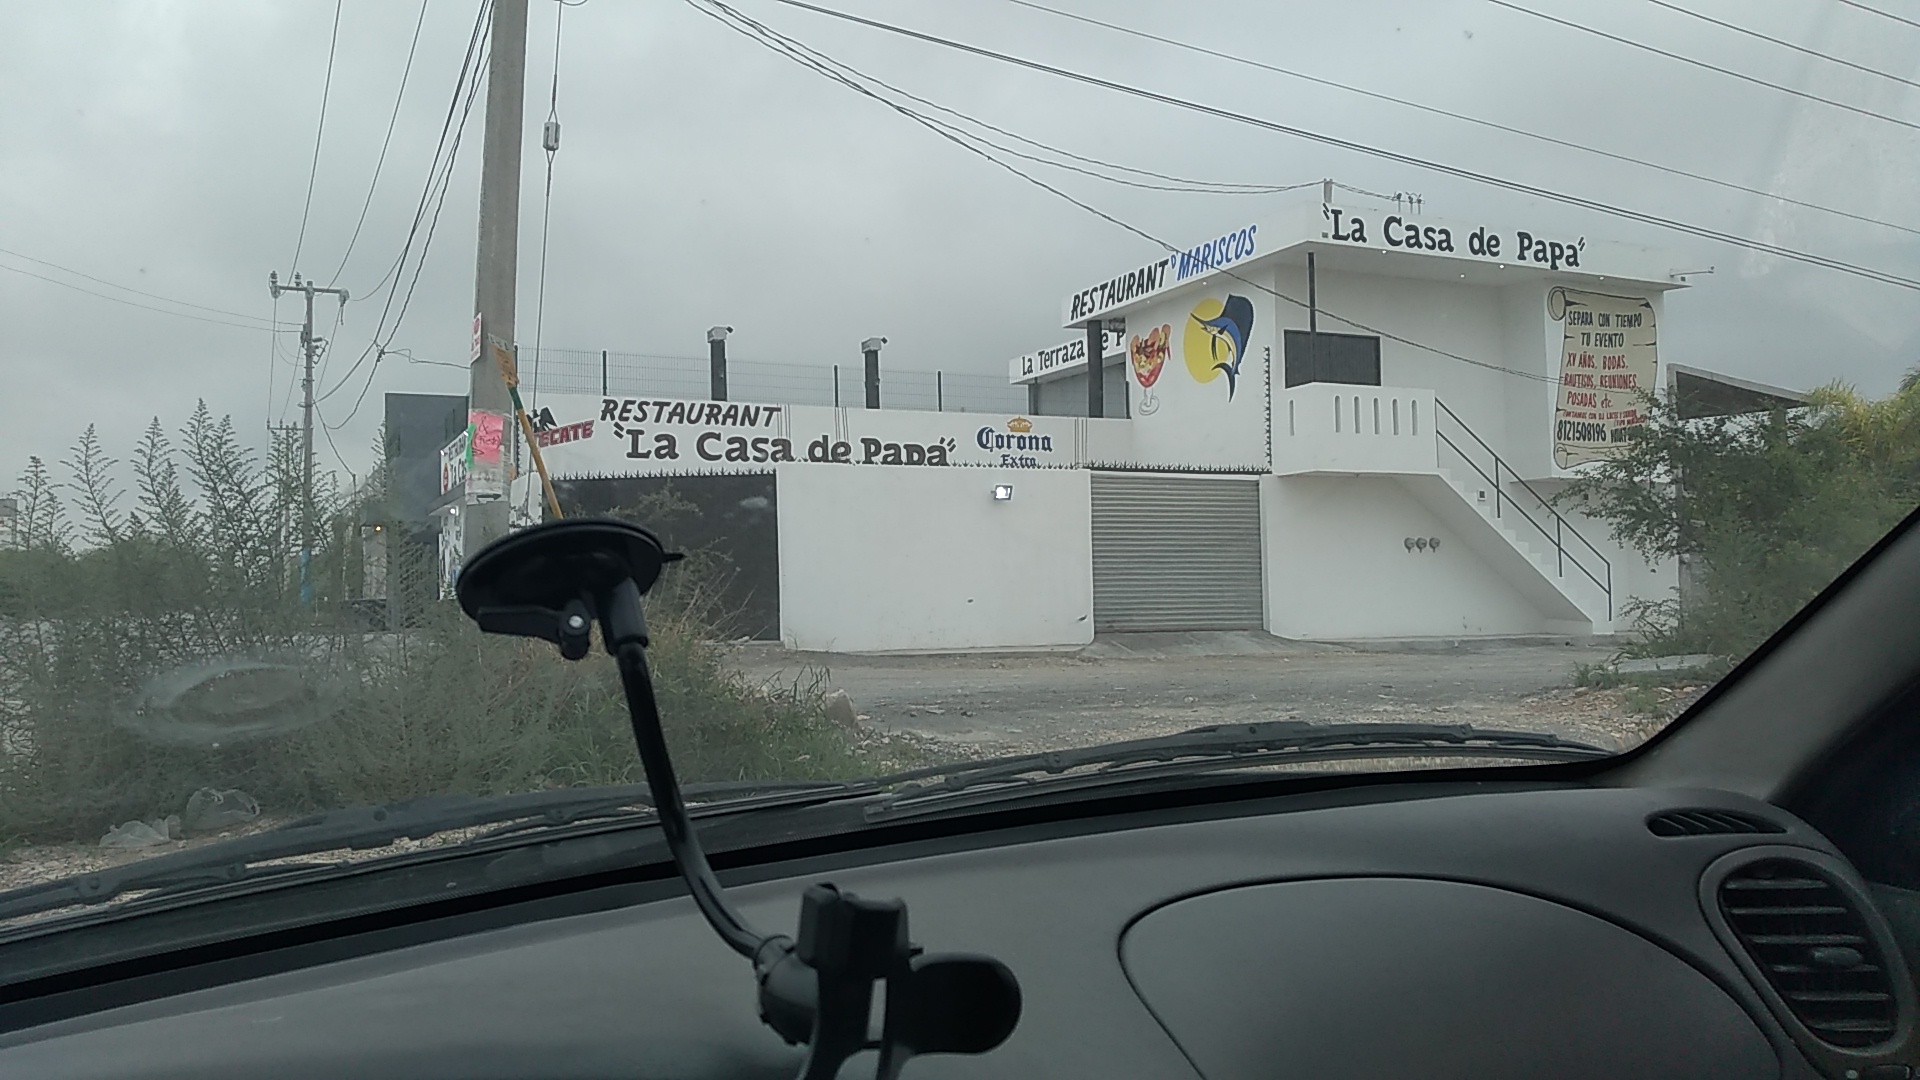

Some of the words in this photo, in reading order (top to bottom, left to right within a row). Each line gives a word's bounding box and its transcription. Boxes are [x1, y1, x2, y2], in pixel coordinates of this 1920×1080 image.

[1383, 215, 1454, 253] Casa
[1468, 226, 1501, 257] de
[1070, 259, 1169, 321] RESTAURANT
[1568, 310, 1593, 326] SEPARA
[1598, 312, 1610, 327] CON
[1615, 312, 1642, 328] TIEMPO
[1580, 332, 1591, 346] TU
[1594, 332, 1624, 348] EVENTO
[1021, 355, 1033, 376] La
[1038, 338, 1085, 371] Terraza
[1566, 352, 1577, 367] XV
[1567, 391, 1597, 408] POSADAS
[600, 399, 781, 428] RESTAURANT
[976, 426, 1053, 453] Corona
[1556, 419, 1606, 442] 8121508196
[695, 431, 793, 463] Casa
[807, 434, 853, 463] de
[1001, 454, 1037, 468] Extra
